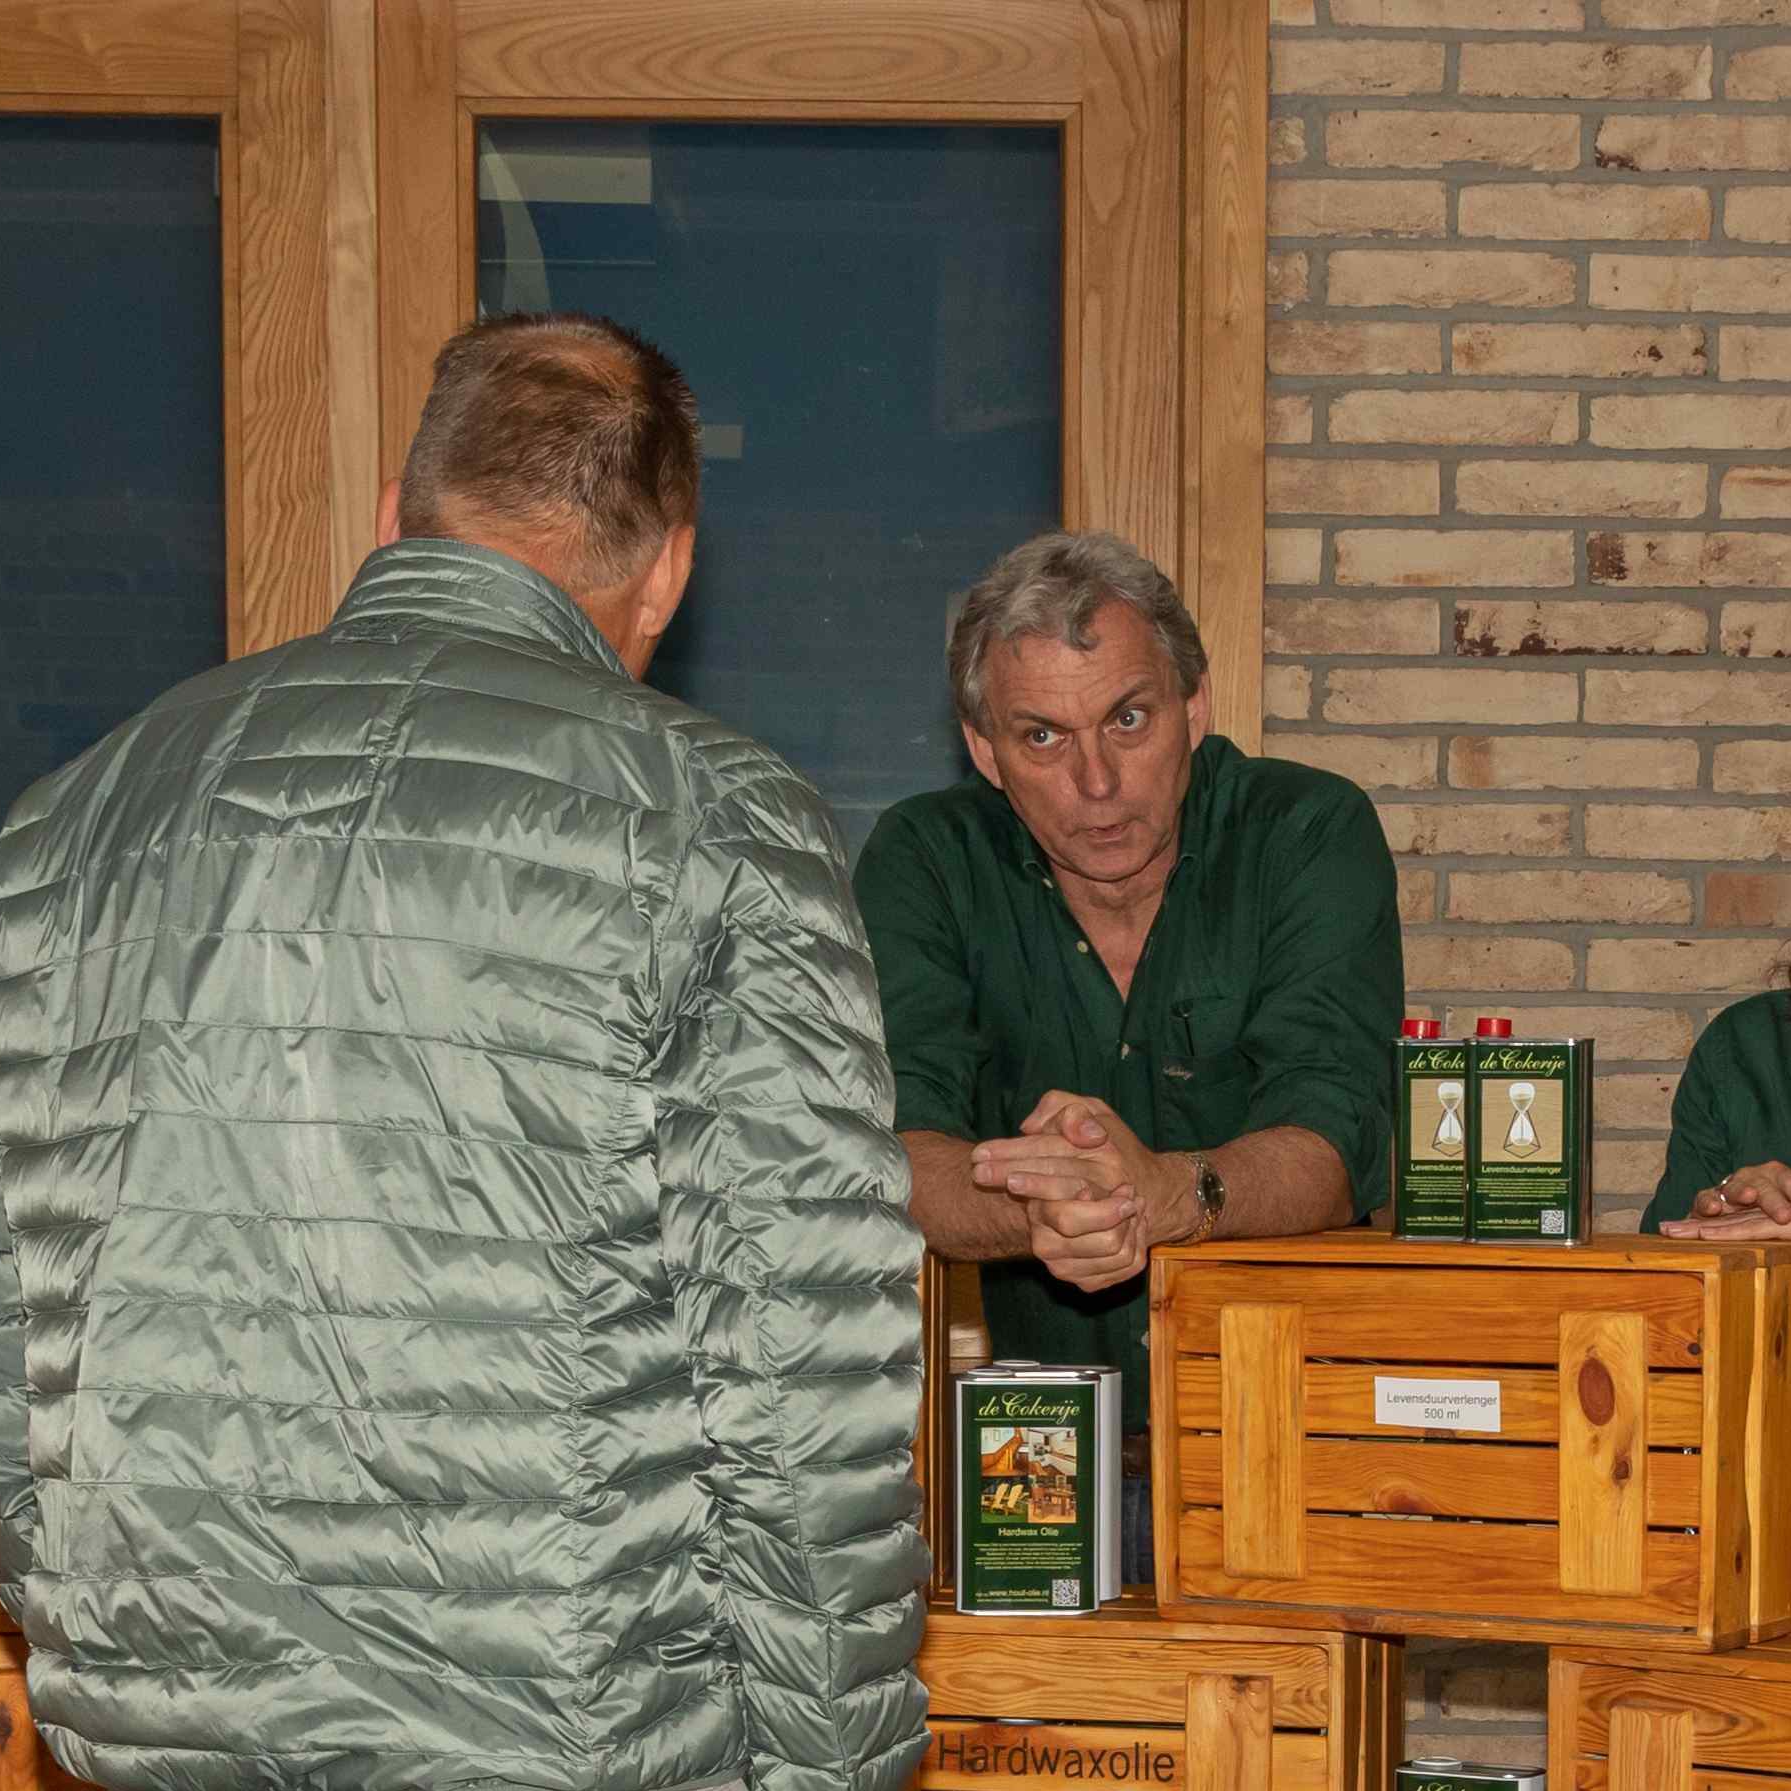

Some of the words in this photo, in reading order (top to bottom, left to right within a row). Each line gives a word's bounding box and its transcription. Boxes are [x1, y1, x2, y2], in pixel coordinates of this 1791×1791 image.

[1409, 1052, 1427, 1070] de
[1427, 1048, 1465, 1071] Coke
[1480, 1052, 1498, 1070] de
[1410, 1163, 1464, 1173] Levensduurve
[978, 1396, 1000, 1417] de
[1386, 1392, 1498, 1408] Levensduurverlenger
[1424, 1408, 1444, 1419] 500
[1447, 1409, 1460, 1419] ml
[998, 1527, 1038, 1537] Hardwax
[1040, 1527, 1059, 1537] Olie
[938, 1734, 1176, 1783] Hardwaxolie
